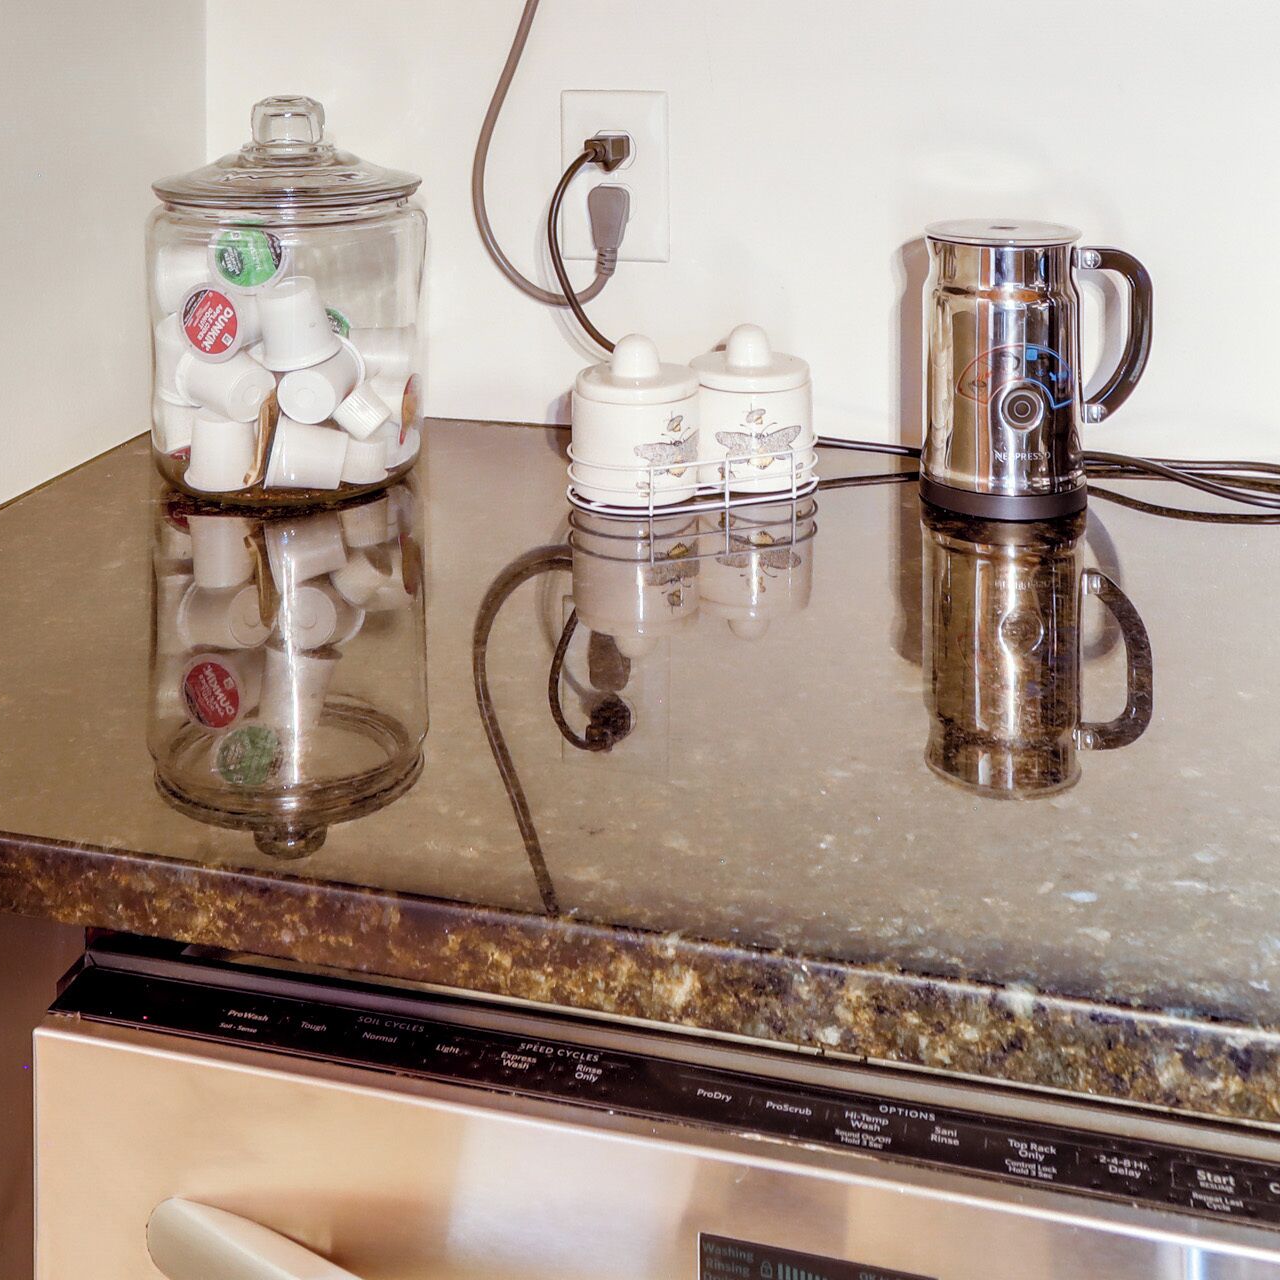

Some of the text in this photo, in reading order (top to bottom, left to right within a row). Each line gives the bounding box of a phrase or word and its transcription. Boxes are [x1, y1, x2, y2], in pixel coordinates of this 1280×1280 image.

[993, 449, 1051, 463] NEPRESSO
[227, 1009, 269, 1022] ProWash
[300, 1021, 327, 1032] Tough
[357, 1015, 424, 1033] SOIL CYCLES
[362, 1031, 398, 1044] Normal
[435, 1044, 460, 1055] Light
[520, 1042, 599, 1063] SPEED CYCLES
[500, 1051, 537, 1064] Express
[502, 1059, 529, 1070] Wash
[576, 1064, 603, 1075] Rinse
[574, 1072, 599, 1083] Only
[696, 1088, 732, 1103] ProDry
[765, 1100, 812, 1116] ProScrub
[879, 1104, 936, 1121] OPTIONS
[844, 1110, 889, 1126] Hi-Temp
[850, 1120, 881, 1132] Wash
[934, 1125, 958, 1138] Sani
[930, 1134, 960, 1146] Rinse
[1008, 1138, 1057, 1155] Top Rack
[1018, 1149, 1045, 1162] Only
[1108, 1164, 1141, 1179] Delay
[1196, 1169, 1236, 1186] Start
